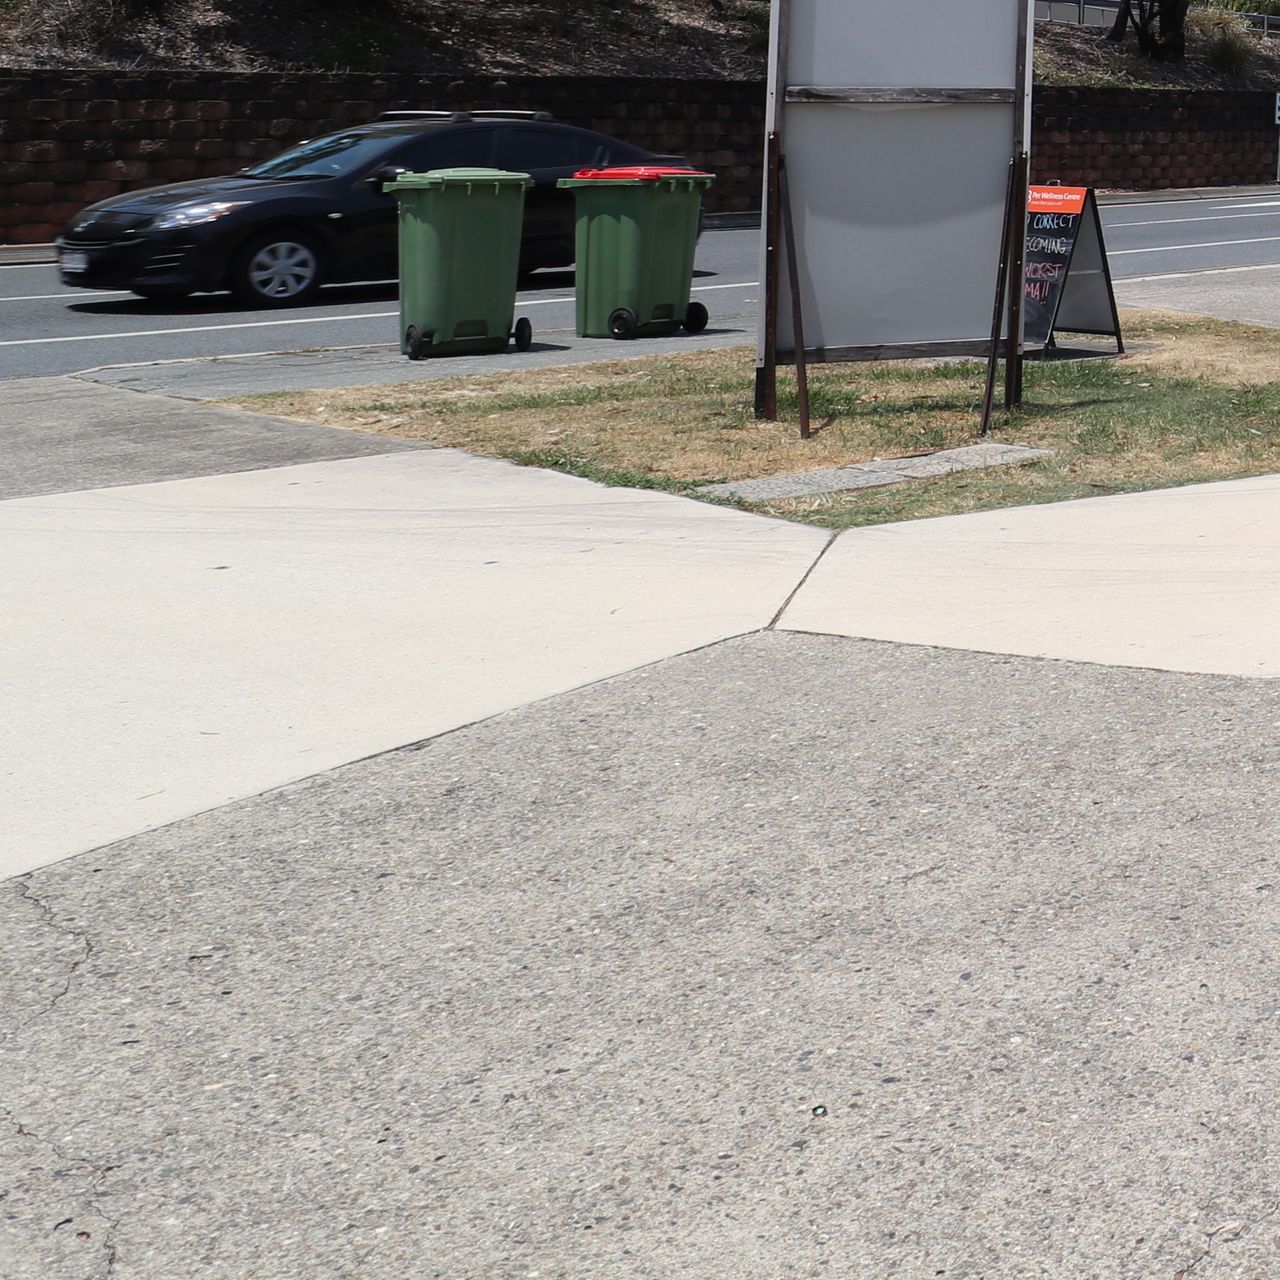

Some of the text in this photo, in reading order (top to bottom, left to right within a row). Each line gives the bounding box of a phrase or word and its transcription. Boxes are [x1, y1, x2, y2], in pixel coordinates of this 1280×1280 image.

[1041, 192, 1063, 200] Wellness
[1033, 213, 1076, 229] CORRECT
[1025, 236, 1067, 254] ECOMING
